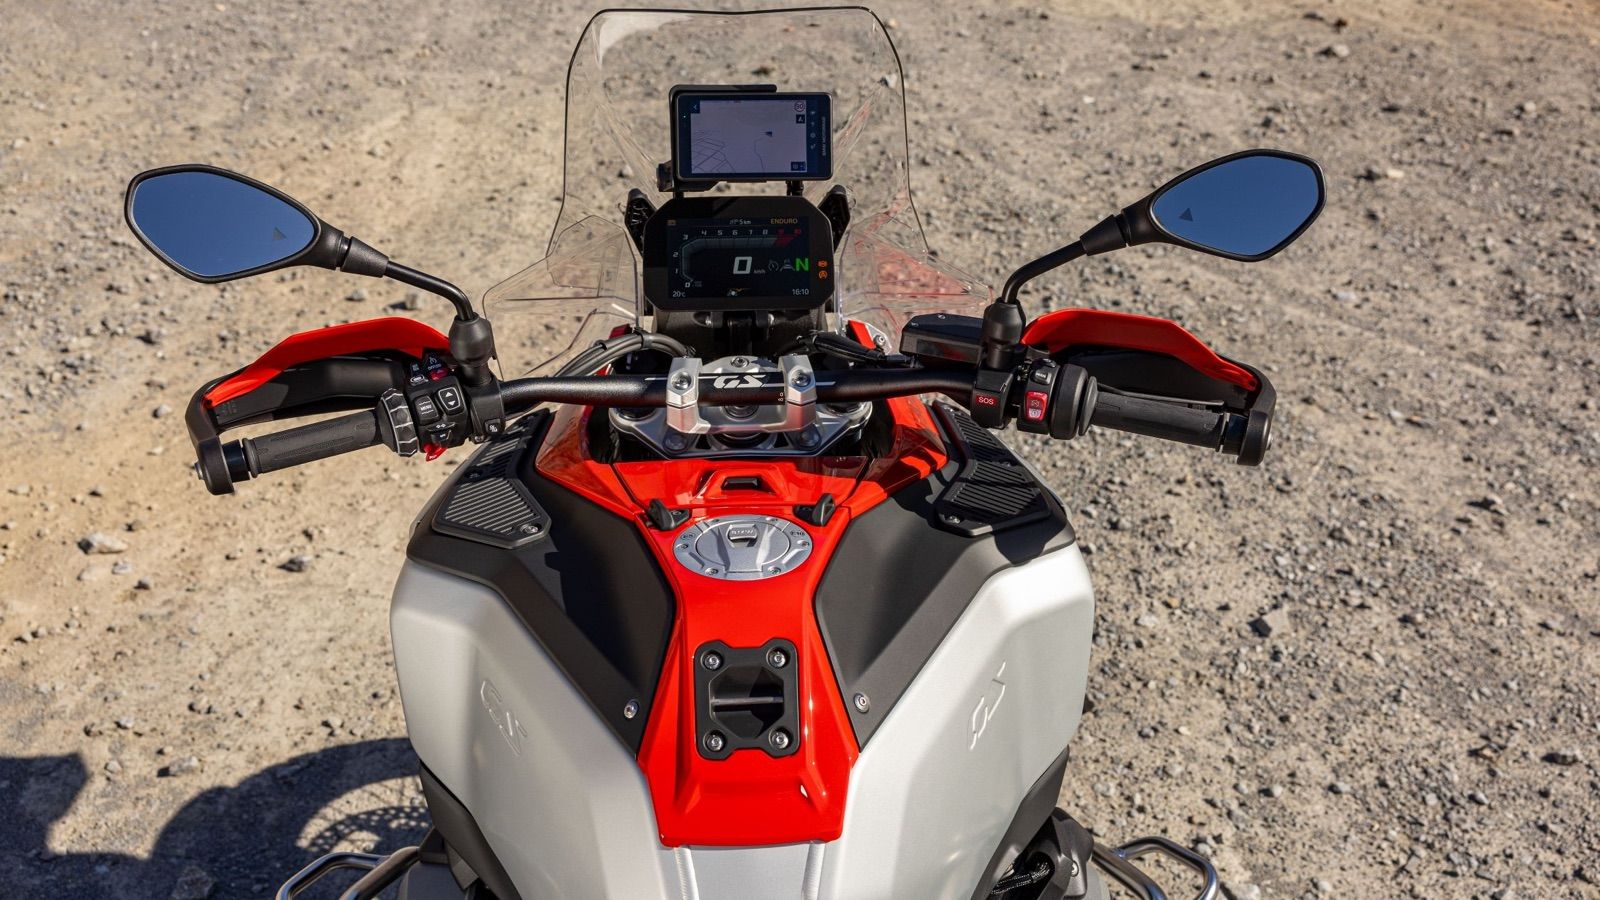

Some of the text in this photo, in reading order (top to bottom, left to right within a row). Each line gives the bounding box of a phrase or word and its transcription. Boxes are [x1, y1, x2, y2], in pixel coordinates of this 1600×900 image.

[733, 256, 753, 275] 0
[795, 257, 809, 272] N
[792, 288, 810, 296] 16:10
[713, 374, 766, 389] GS
[978, 396, 994, 405] SOS
